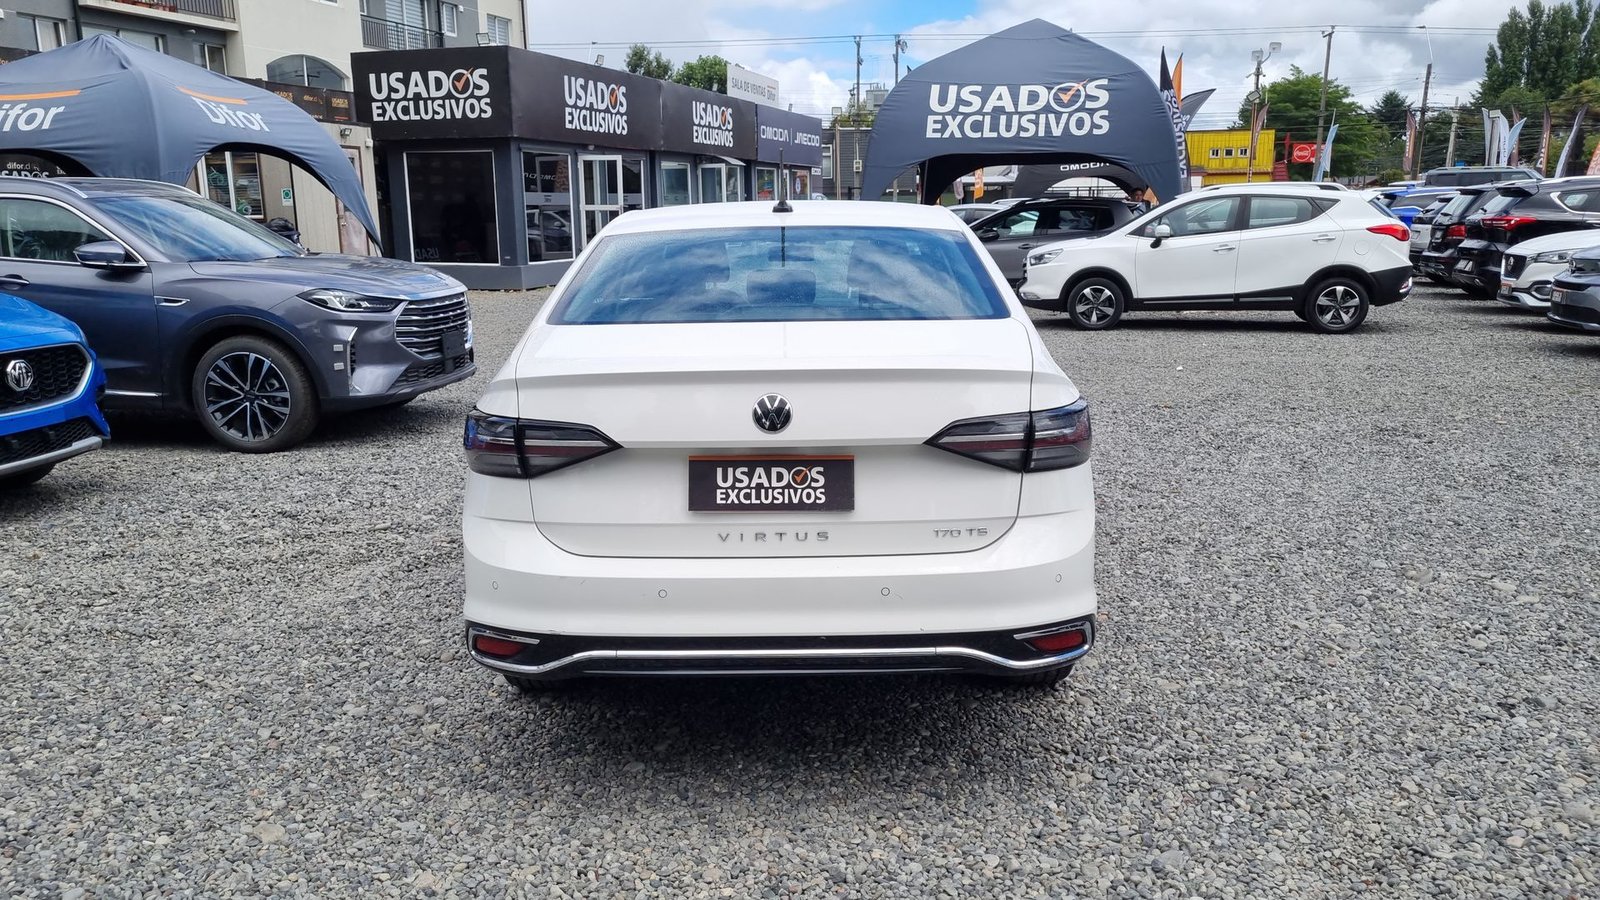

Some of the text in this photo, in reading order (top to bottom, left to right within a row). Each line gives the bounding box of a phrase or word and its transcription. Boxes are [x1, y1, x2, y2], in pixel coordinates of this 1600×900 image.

[368, 68, 490, 99] USADOS
[563, 75, 627, 113] USADOS
[731, 77, 743, 90] SALA
[744, 81, 750, 93] DE
[750, 84, 766, 98] VENTAS
[928, 78, 1110, 113] USADOS
[0, 103, 65, 132] ifor
[191, 96, 270, 132] Difor
[371, 98, 493, 122] EXCLUSIVOS
[564, 107, 628, 135] EXCLUSIVOS
[692, 100, 733, 130] USADOS
[693, 126, 734, 147] EXCLUSIVOS
[760, 125, 789, 142] OMODA
[925, 110, 1110, 138] EXCLUSIVOS
[716, 466, 825, 488] USADOS
[716, 488, 826, 504] EXCLUSIVOS
[717, 531, 830, 543] VIRTUS
[933, 528, 962, 538] 170
